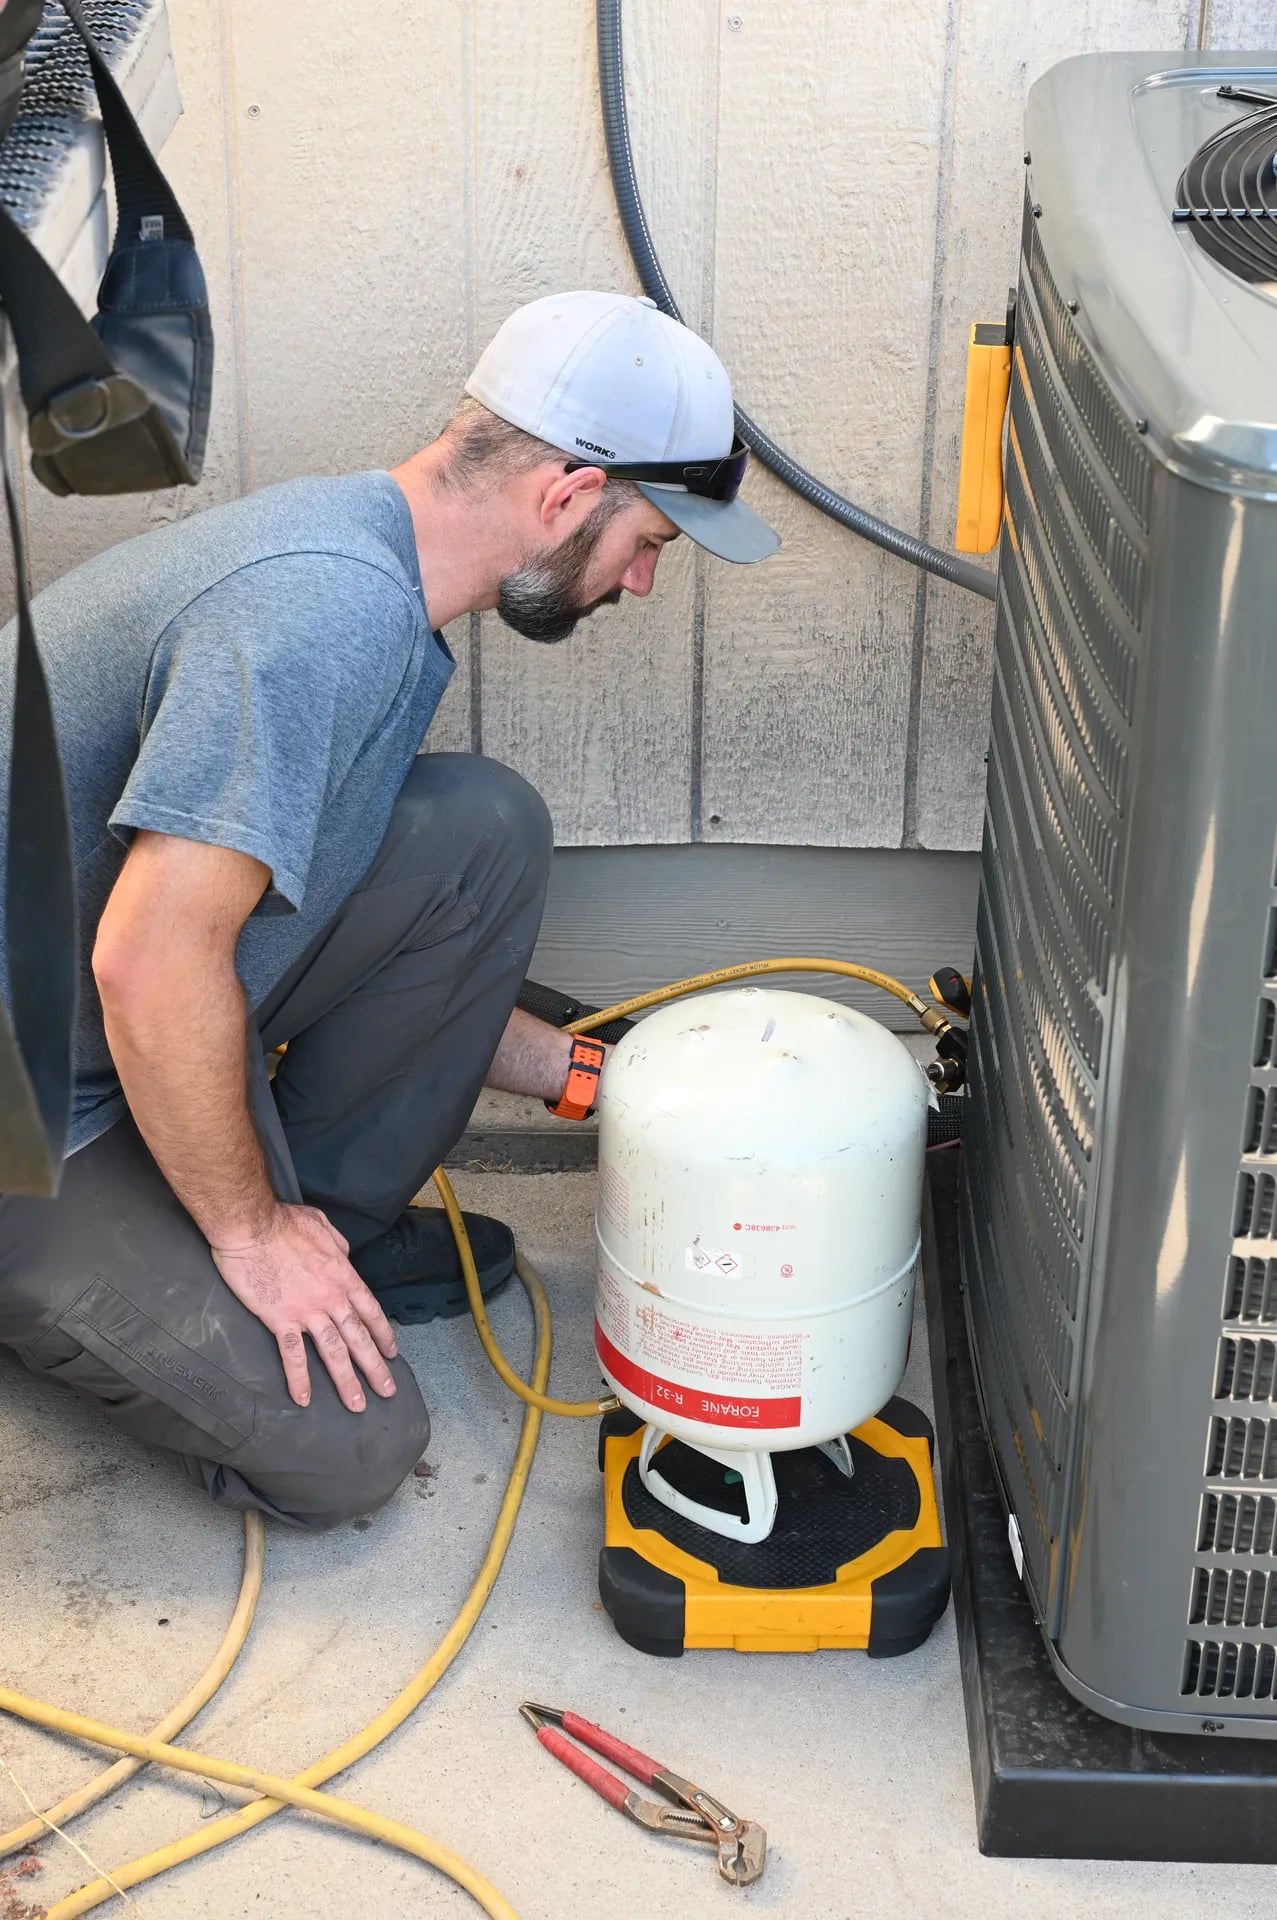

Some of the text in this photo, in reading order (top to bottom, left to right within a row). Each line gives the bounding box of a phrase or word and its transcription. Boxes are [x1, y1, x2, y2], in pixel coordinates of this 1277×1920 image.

[576, 437, 616, 459] WORKS
[721, 1376, 762, 1384] flammable
[656, 1385, 759, 1418] FORANE R-32
